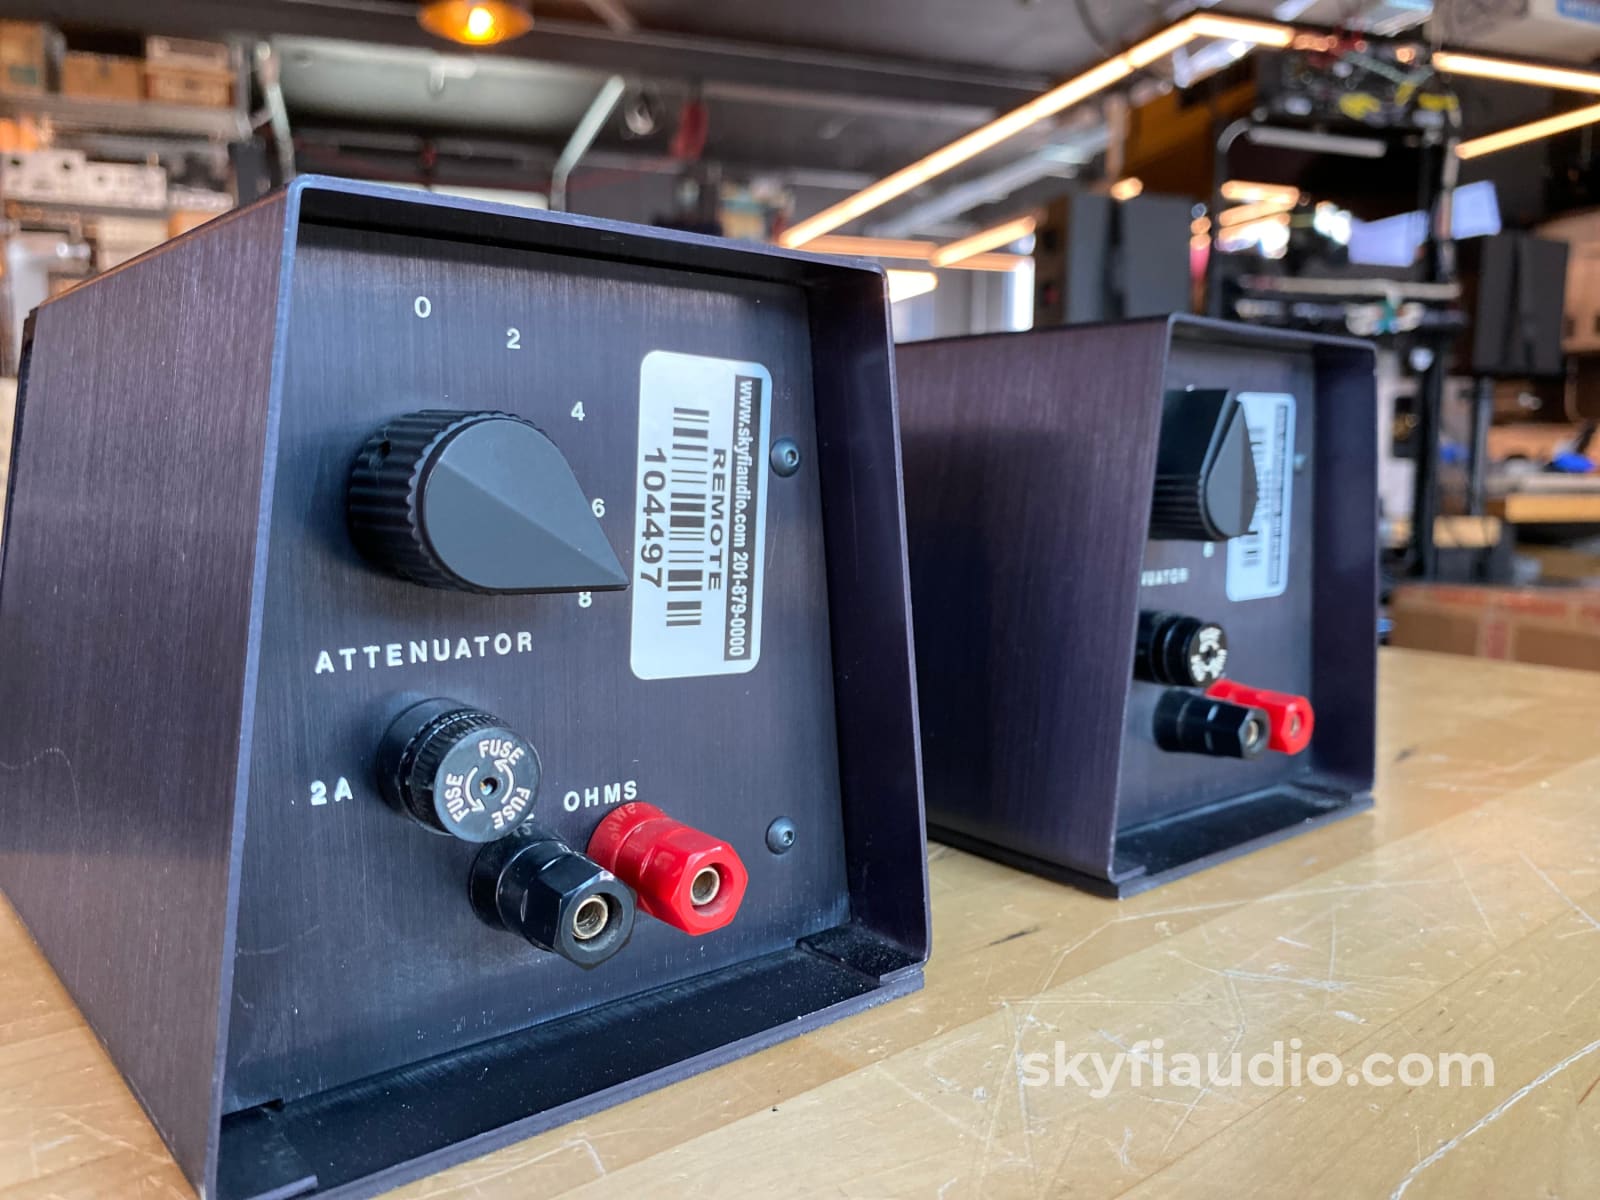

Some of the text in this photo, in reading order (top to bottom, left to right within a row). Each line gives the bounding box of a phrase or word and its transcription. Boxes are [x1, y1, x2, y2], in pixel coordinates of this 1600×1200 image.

[414, 296, 431, 318] 0
[506, 328, 521, 350] 2
[571, 401, 585, 421] 4
[592, 498, 605, 518] 6
[640, 448, 668, 589] 104497
[708, 448, 727, 591] REMOTE
[729, 380, 754, 657] www.skyfiaudio.com 201-879-0000
[578, 591, 592, 608] 8
[315, 631, 534, 674] ATTENUATOR
[479, 739, 525, 766] FUSE
[444, 773, 470, 823] FUSE
[491, 787, 531, 830] FUSE
[563, 780, 638, 812] OHMS
